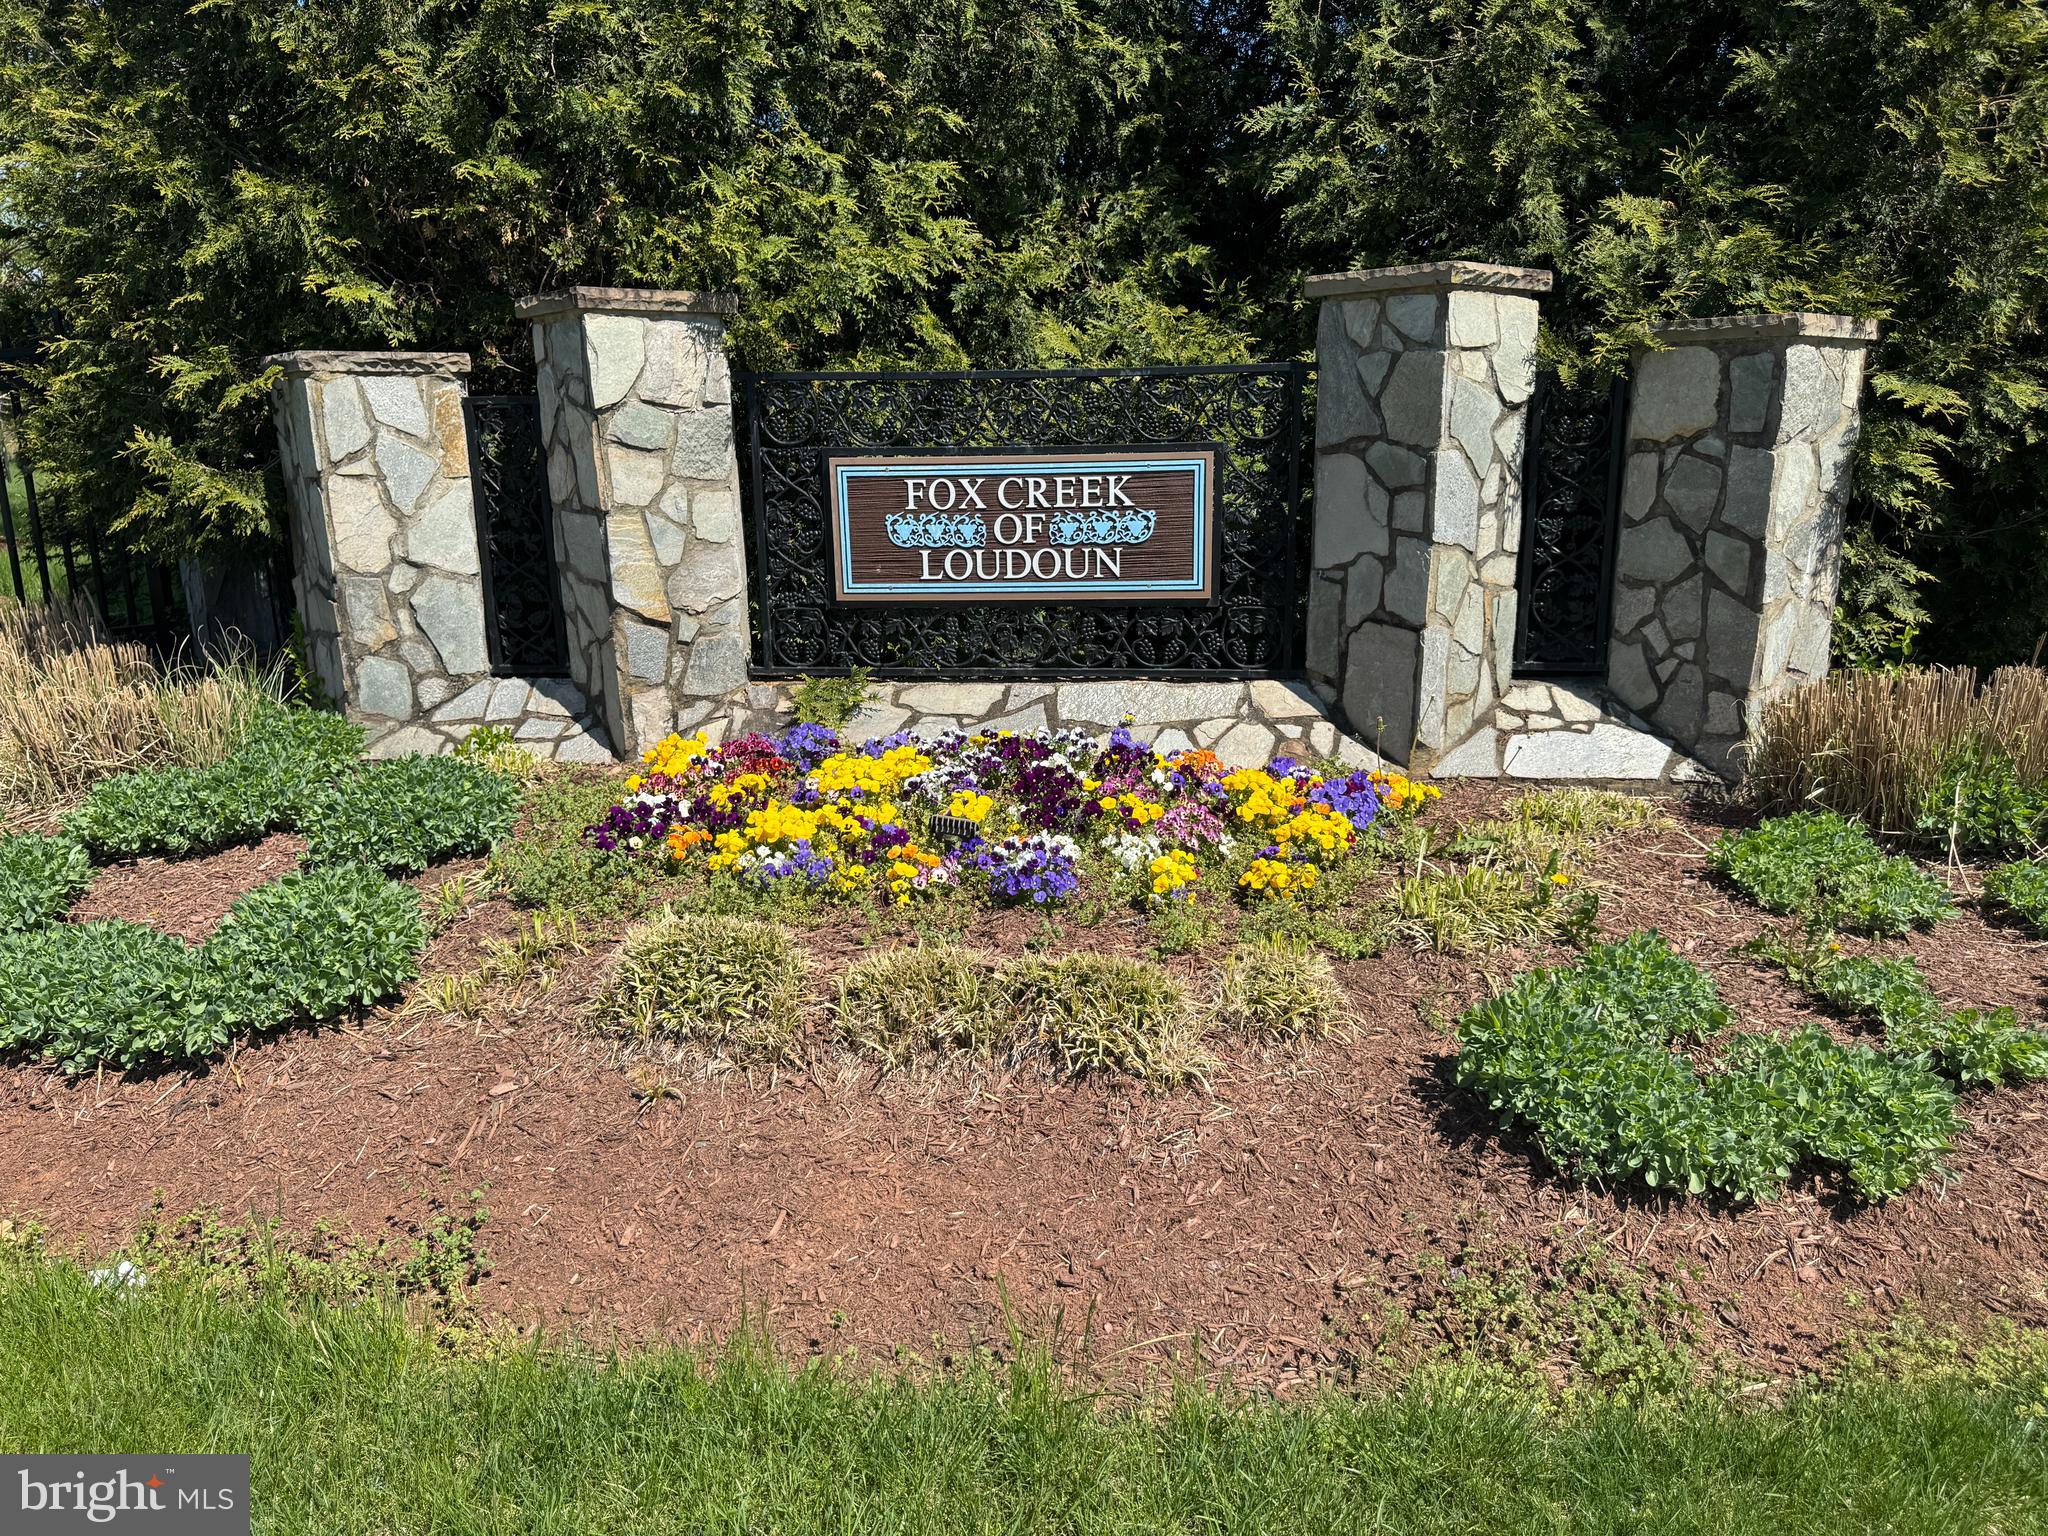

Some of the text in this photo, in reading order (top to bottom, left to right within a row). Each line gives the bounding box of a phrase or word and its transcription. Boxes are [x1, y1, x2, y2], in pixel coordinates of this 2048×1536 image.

[903, 475, 1136, 511] FOX CREEK
[993, 513, 1046, 546] OF
[918, 547, 1123, 581] LOUDOUN
